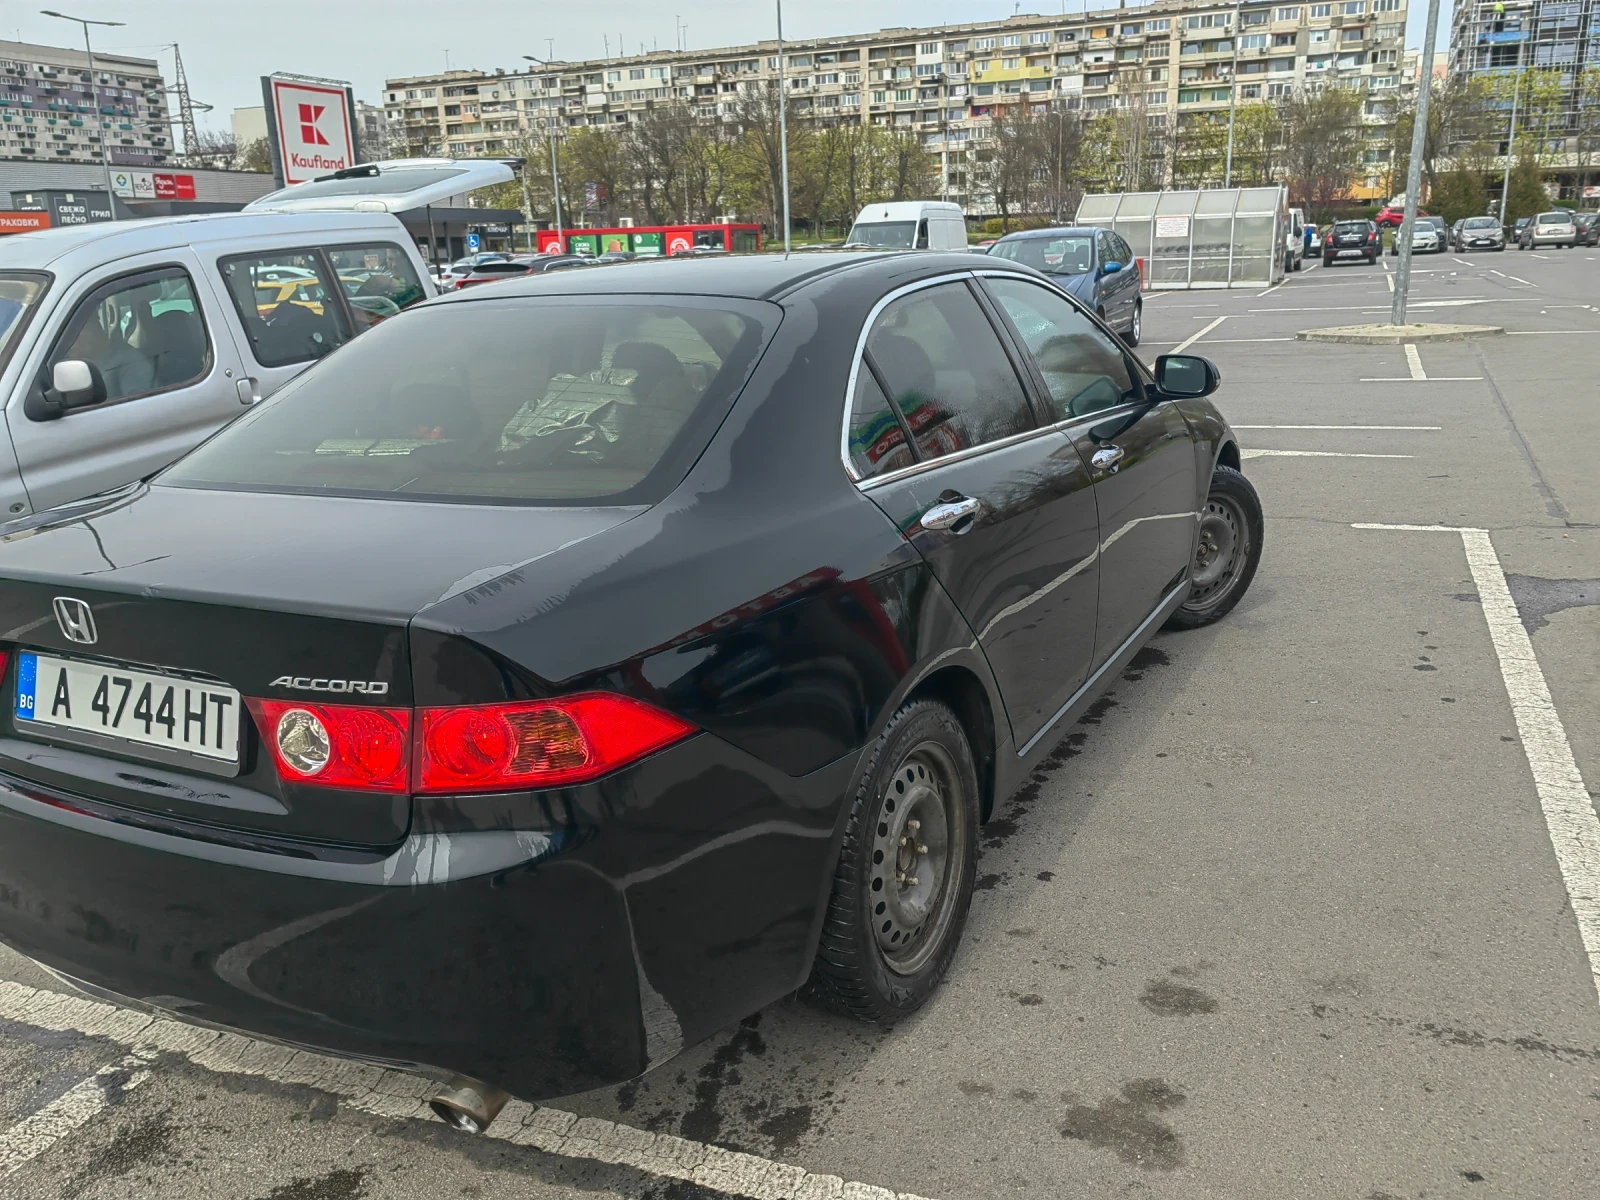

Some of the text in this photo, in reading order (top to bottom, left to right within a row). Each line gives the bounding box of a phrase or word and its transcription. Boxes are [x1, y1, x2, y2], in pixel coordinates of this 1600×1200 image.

[291, 152, 345, 170] Kaufland
[58, 205, 86, 213] СВЕЖО
[90, 210, 111, 218] ГРИЛ
[268, 675, 389, 695] ACCORD
[19, 693, 34, 709] BG
[51, 667, 233, 750] A 4744HT
